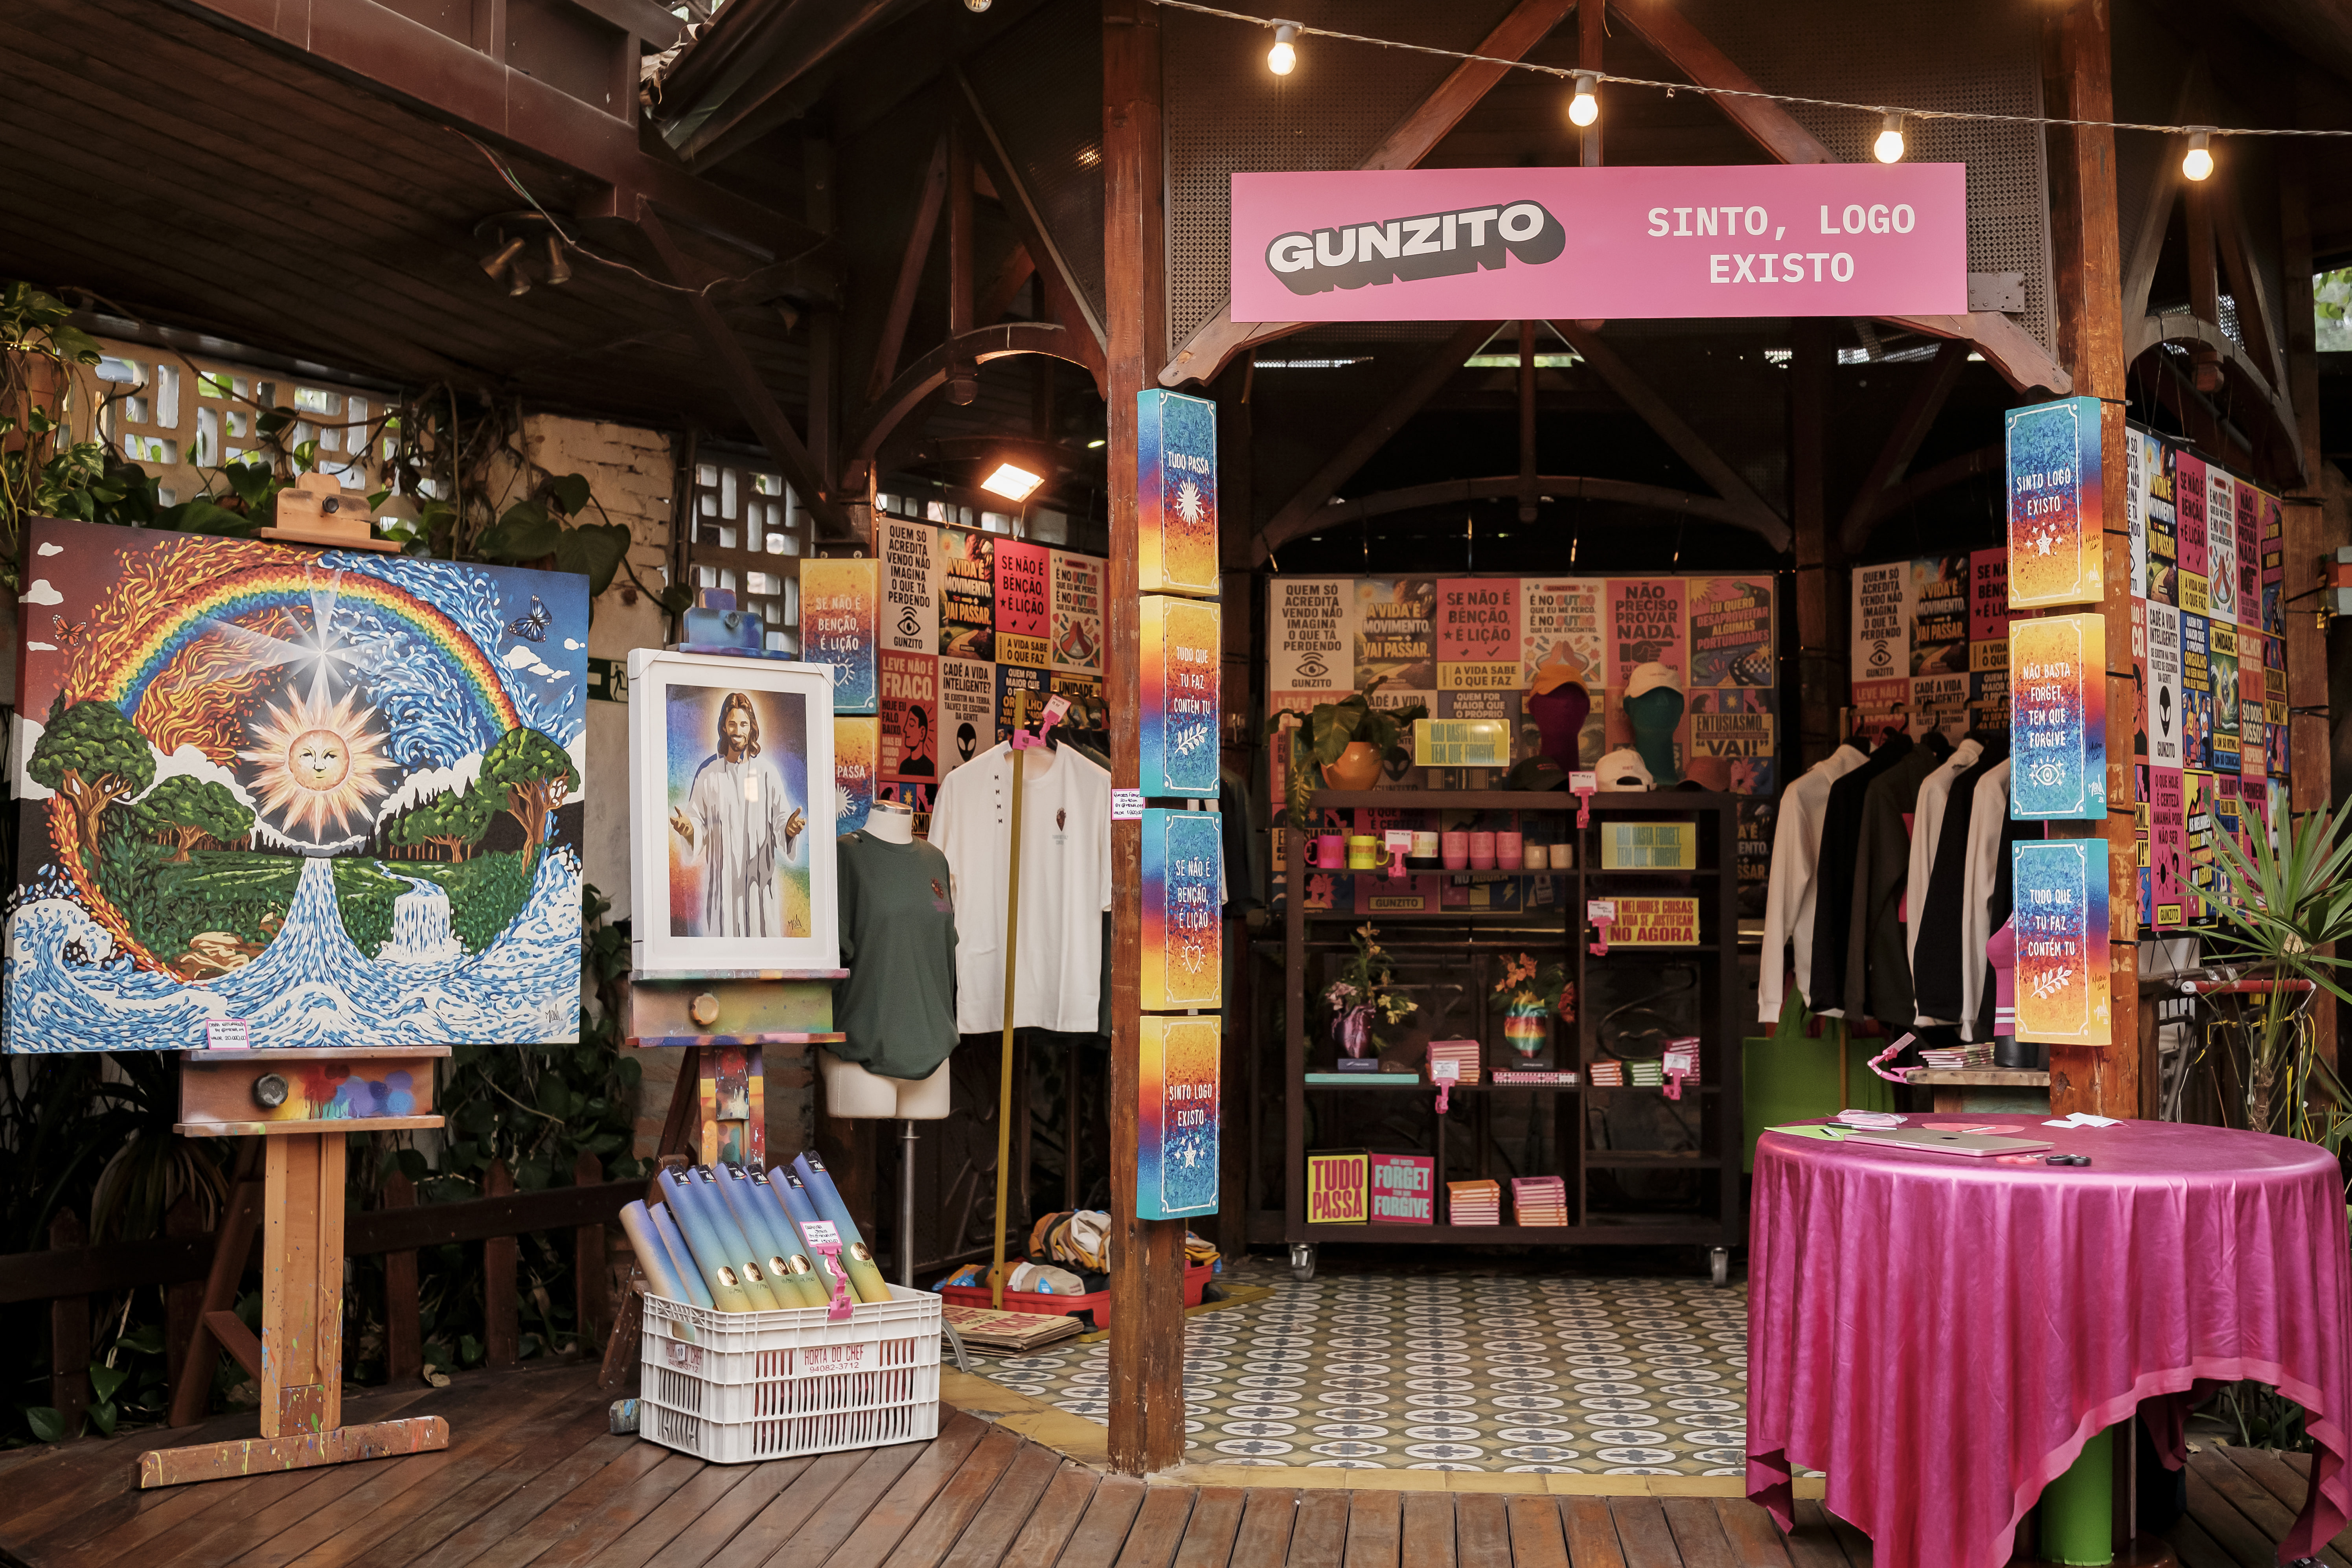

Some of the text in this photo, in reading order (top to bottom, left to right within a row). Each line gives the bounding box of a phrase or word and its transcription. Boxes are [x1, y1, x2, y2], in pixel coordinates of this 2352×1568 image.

[1647, 204, 1916, 241] SINTO, LOGO
[1267, 202, 1545, 274] GUNZITO
[1710, 252, 1855, 284] EXISTO
[1168, 451, 1209, 475] TUDO PASSA
[2017, 467, 2071, 492] SINTO LOGO
[2027, 495, 2061, 516] EXISTO
[890, 525, 927, 542] QUEM SÓ
[2149, 529, 2157, 553] VAI
[888, 539, 927, 556] ACREDITA
[886, 551, 930, 570] VENDO NÃO
[947, 557, 985, 579] A VIDA É
[1002, 555, 1043, 576] SE NÃO É
[891, 565, 926, 582] IMAGINA
[892, 579, 926, 595] O QUE TÁ
[945, 575, 991, 597] MOVIMENTO.
[1003, 574, 1044, 598] BÊNÇÃO,
[1286, 583, 1338, 596] QUEM SÓ
[1626, 582, 1665, 599] NÃO
[1862, 581, 1900, 594] ACREDITA
[816, 594, 861, 610] SE NÃO É
[888, 591, 930, 608] PERDENDO
[1008, 594, 1044, 617] É LIÇÃO
[1285, 597, 1339, 606] ACREDITA
[1447, 589, 1510, 605] SE NÃO É
[1616, 600, 1678, 611] PRECISO
[945, 601, 991, 624] VAI PASSAR.
[1449, 607, 1510, 627] BÊNÇÃO,
[1616, 612, 1677, 623] PROVAR
[2150, 608, 2176, 631] CADÊ A VIDA
[818, 616, 859, 633] BENÇÃO,
[1617, 624, 1681, 639] NADA.
[894, 636, 923, 649] GUNZITO
[1456, 626, 1510, 644] É LIÇÃO
[1861, 627, 1901, 641] PERDENDO
[2150, 627, 2177, 648] INTELIGENTE?
[2215, 631, 2234, 653] UNIDADE
[820, 635, 859, 653] É LIÇÃO
[1007, 638, 1047, 653] A VIDA SABE
[1284, 641, 1341, 651] PERDENDO
[1007, 650, 1044, 664] O QUE FAZ
[1177, 646, 1208, 664] TUDO QUE
[2185, 651, 2207, 669] ORGULHO
[883, 656, 933, 675] LEVE NÃO É
[943, 662, 988, 680] CADÊ A VIDA
[1866, 667, 1894, 678] GUNZITO
[2023, 662, 2071, 680] NÃO BASTA
[883, 672, 934, 701] FRACO.
[943, 677, 991, 693] INTELIGENTE?
[1180, 673, 1204, 689] TU FAZ
[2030, 685, 2064, 702] FORGET,
[1174, 695, 1210, 715] CONTÉM TU
[2243, 700, 2262, 723] SÓ DOIS
[2028, 708, 2066, 726] TEM QUE
[2030, 731, 2066, 748] FORGIVE
[2243, 722, 2263, 744] DISSO?
[2157, 741, 2175, 758] GUNZITO
[837, 765, 865, 779] PASSA
[2155, 775, 2158, 785] O
[2169, 776, 2179, 789] HOJE
[2157, 789, 2179, 807] É CERTEZA
[2153, 809, 2182, 826] AMANHÃ PODE
[2159, 827, 2178, 845] NÃO SER
[1176, 857, 1210, 877] SE NÃO É
[1178, 884, 1208, 906] BENÇÃO,
[2030, 889, 2072, 904] TUDO QUE
[1621, 900, 1659, 913] MELHORES
[1663, 900, 1694, 913] COISAS
[2161, 908, 2178, 921] GUNZITO
[1179, 908, 1208, 931] É LIÇÃO
[1622, 915, 1694, 926] VIDA SE JUSTIFICAM
[2036, 915, 2067, 931] TU FAZ
[1610, 928, 1694, 941] NO AGORA
[2028, 937, 2075, 957] CONTÉM TU
[1169, 1083, 1212, 1101] SINTO LOGO
[1178, 1109, 1204, 1127] EXISTO
[1313, 1159, 1363, 1191] TUDO
[1375, 1165, 1429, 1191] FORGET
[1313, 1189, 1363, 1219] PASSA
[1374, 1196, 1429, 1218] FORGIVE
[678, 1348, 683, 1357] 10
[691, 1348, 702, 1365] CHEF
[805, 1345, 864, 1366] HORTA DO CHEF
[810, 1362, 859, 1373] 94082-3712
